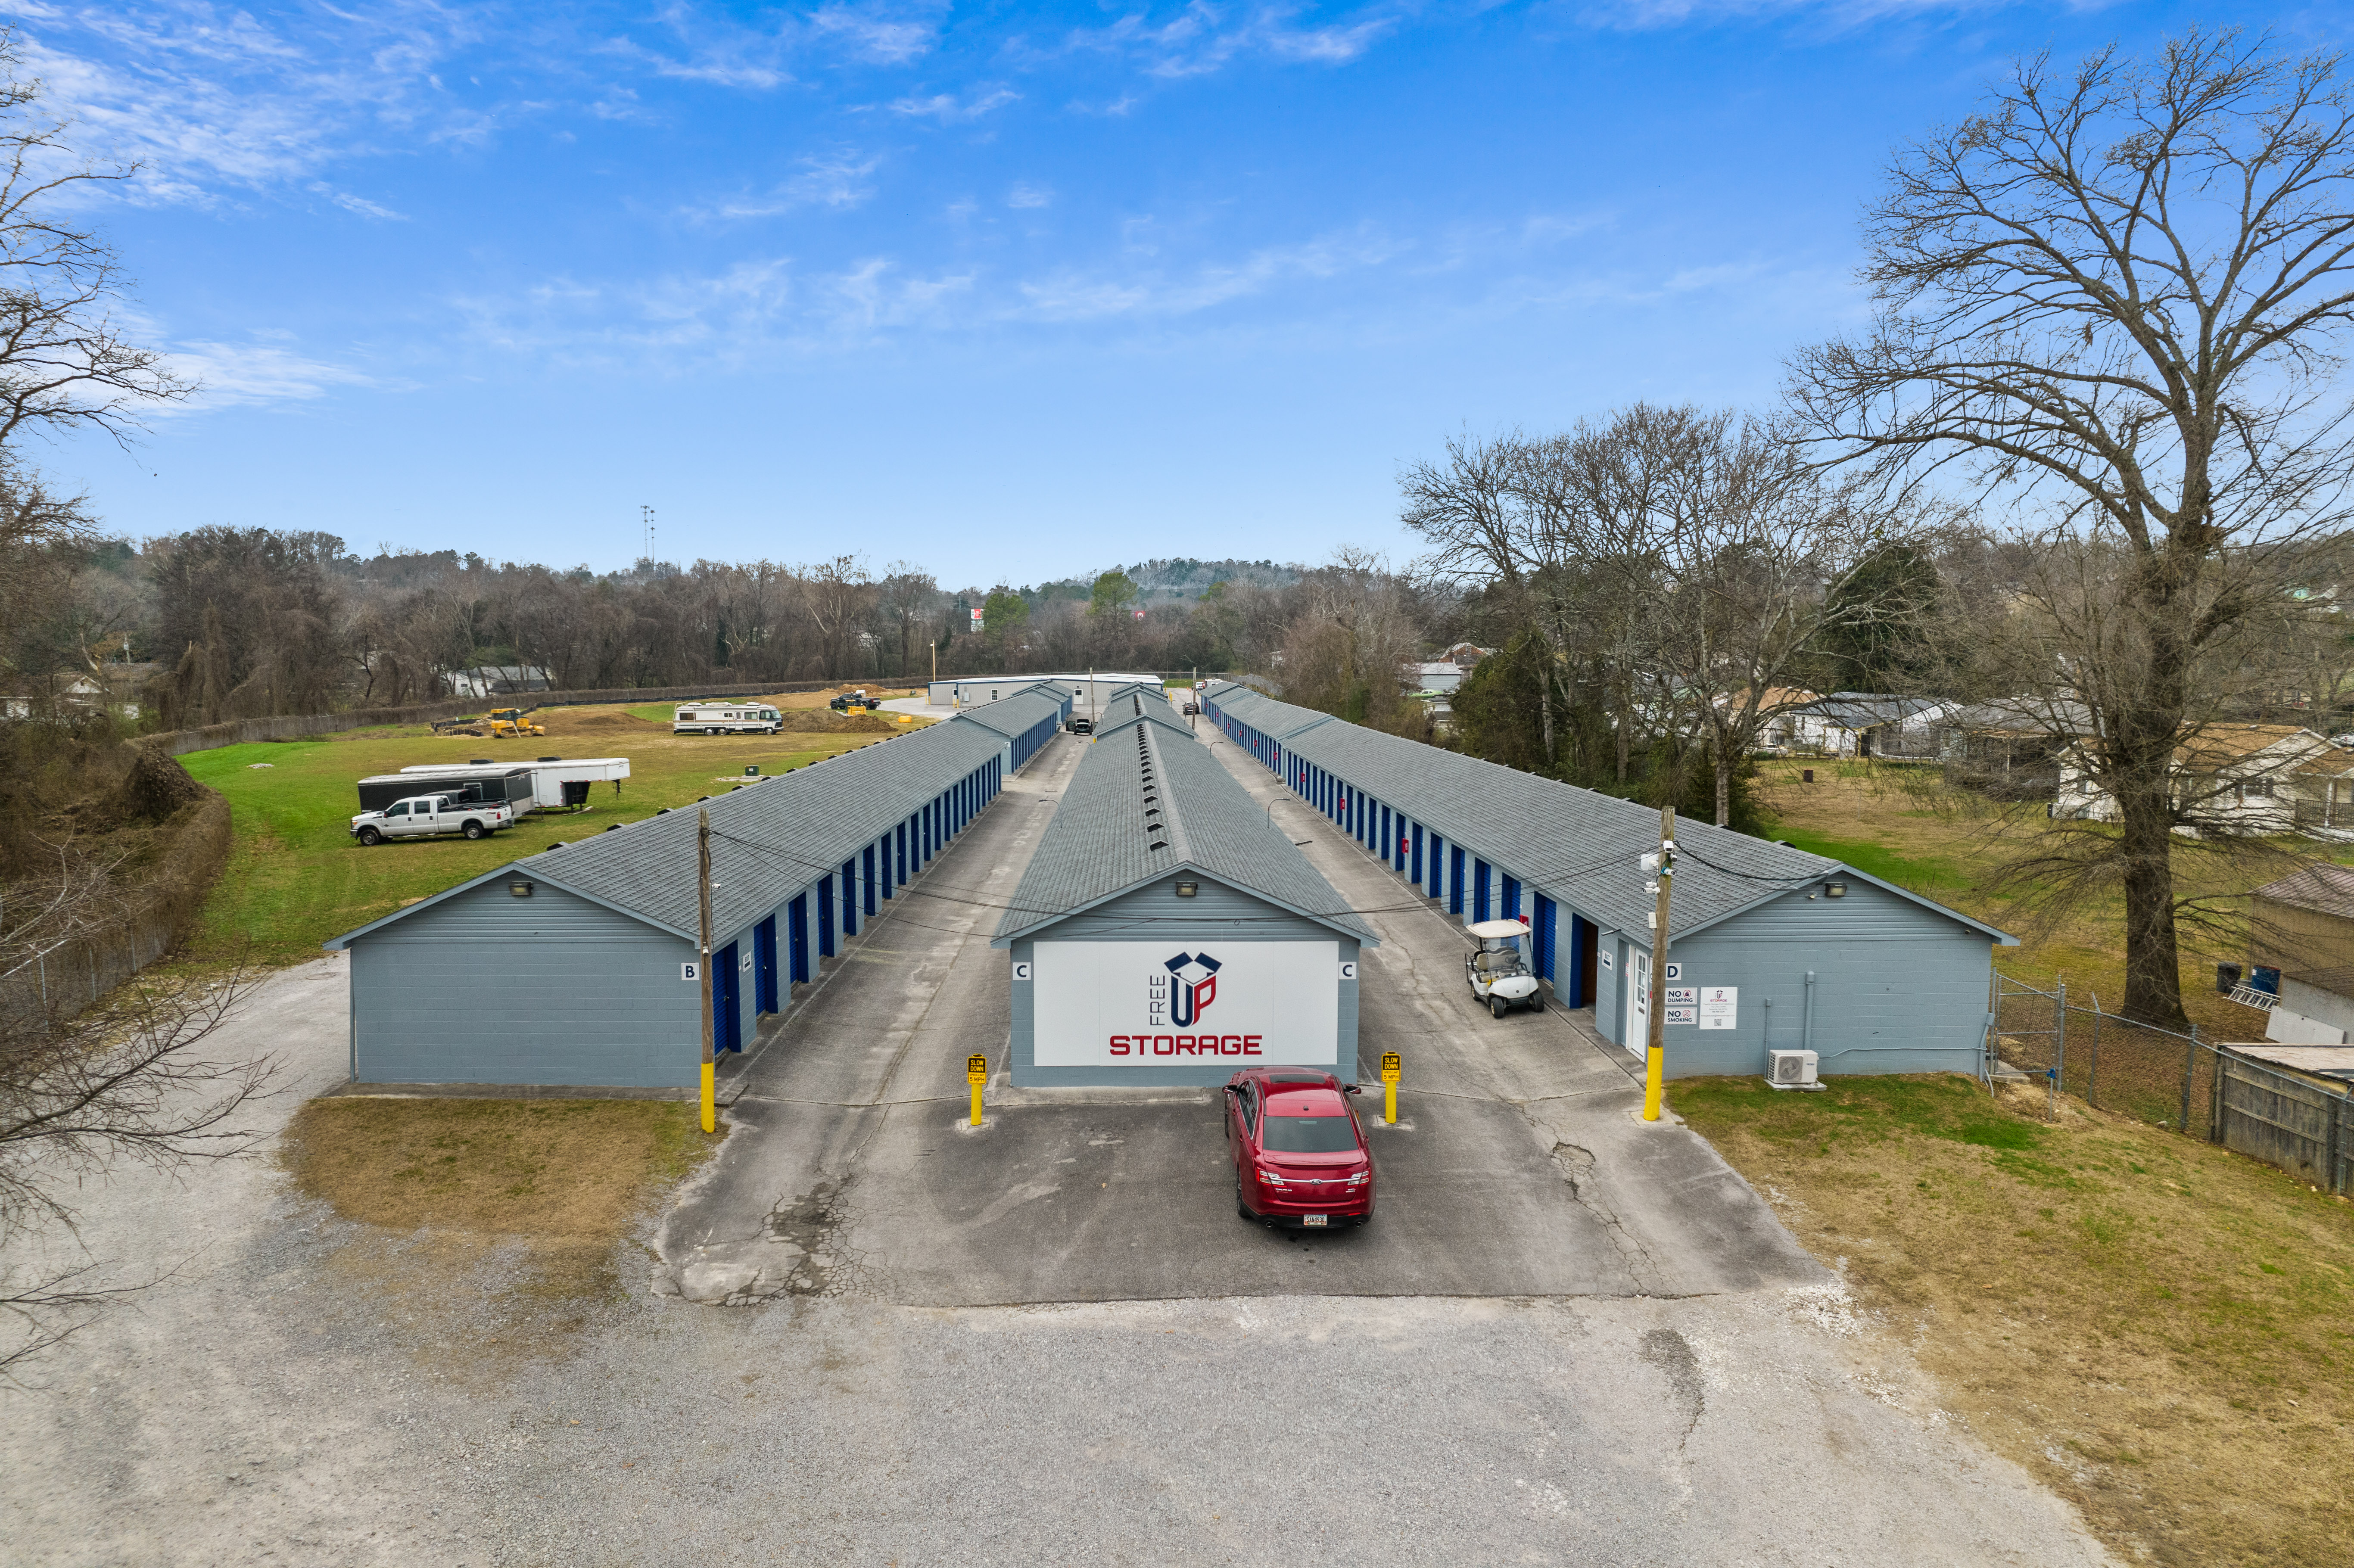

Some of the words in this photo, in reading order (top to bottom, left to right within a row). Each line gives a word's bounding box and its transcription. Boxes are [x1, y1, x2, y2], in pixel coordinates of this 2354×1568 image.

[685, 965, 695, 978] B
[1017, 965, 1027, 977] C
[1342, 964, 1353, 977] C
[1667, 965, 1678, 978] D
[1150, 975, 1165, 1025] FREE
[1171, 975, 1216, 1027] UP
[1110, 1035, 1262, 1055] STORAGE
